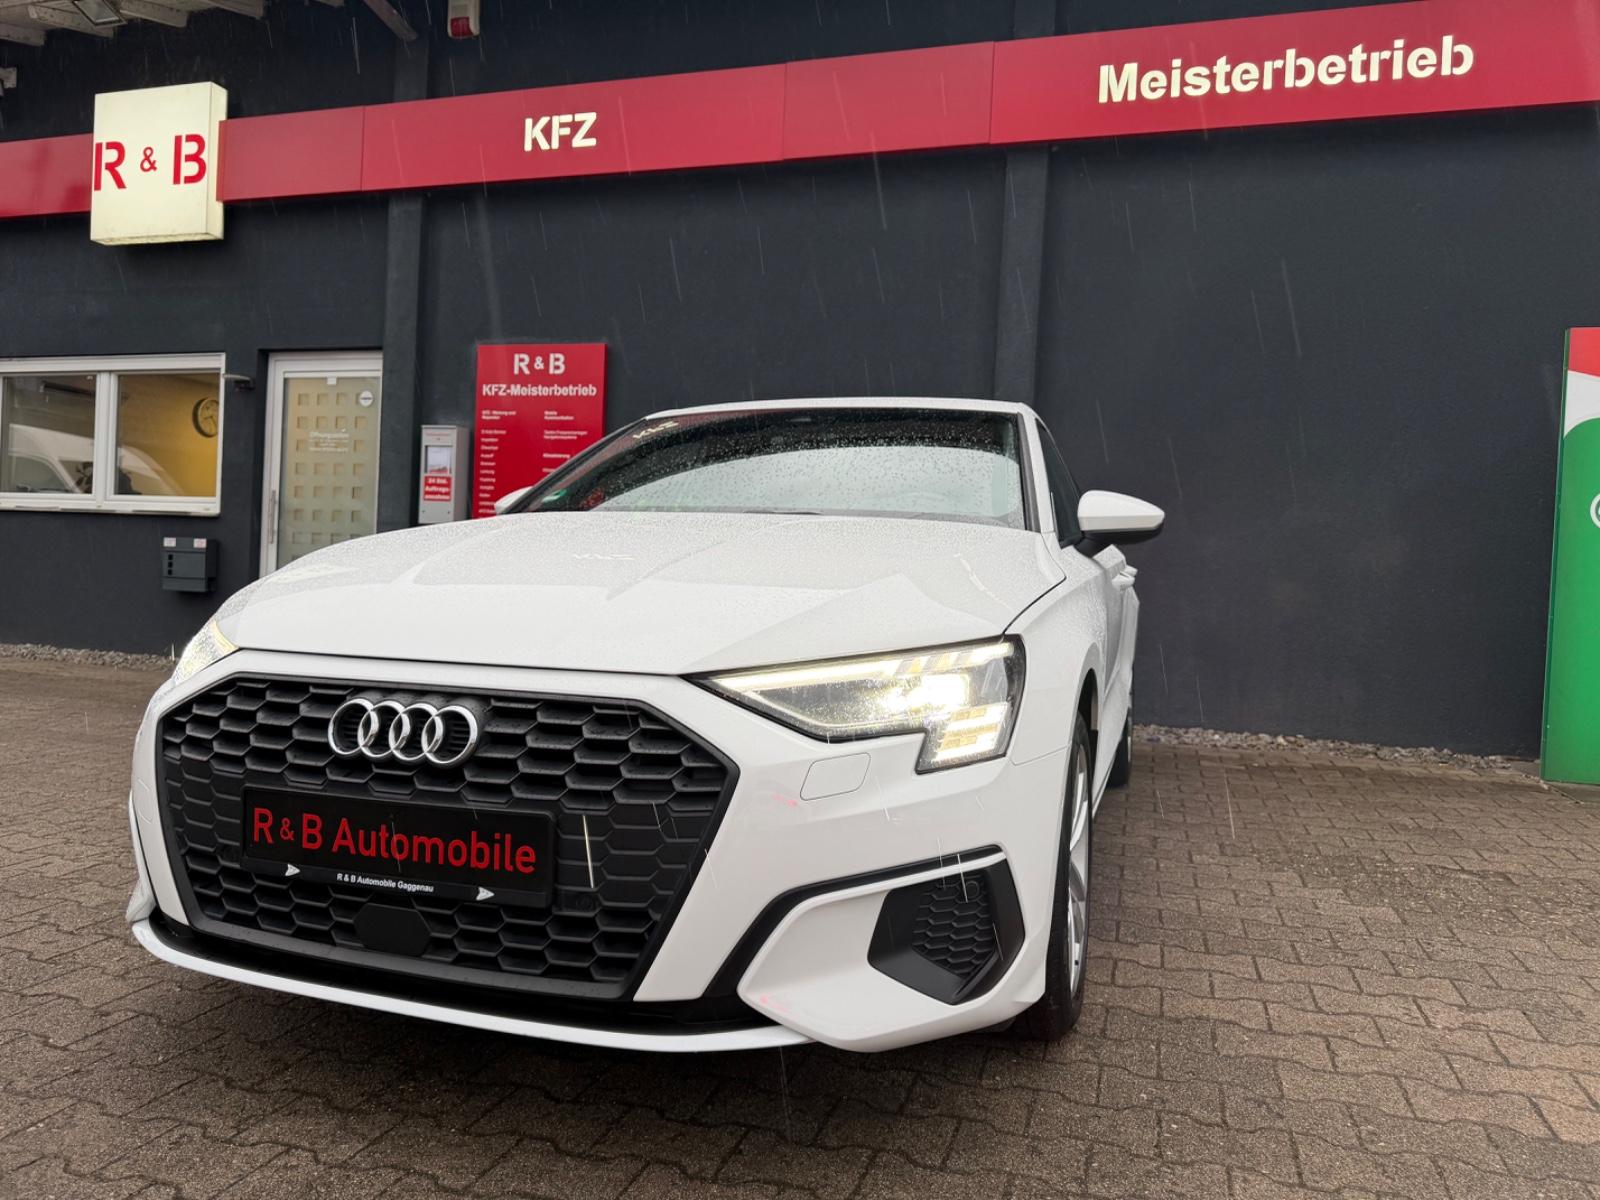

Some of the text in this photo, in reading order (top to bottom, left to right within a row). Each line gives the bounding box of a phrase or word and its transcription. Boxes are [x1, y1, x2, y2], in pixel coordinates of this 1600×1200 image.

[1099, 35, 1474, 103] Meisterbetrieb
[524, 112, 597, 152] KFZ
[94, 134, 207, 191] R & B
[513, 353, 566, 375] R & B
[482, 383, 598, 397] KFZ-Meisterbetrieb
[254, 807, 536, 874] R & B Automobile
[337, 873, 434, 892] R & B Automobile Gaggenau
